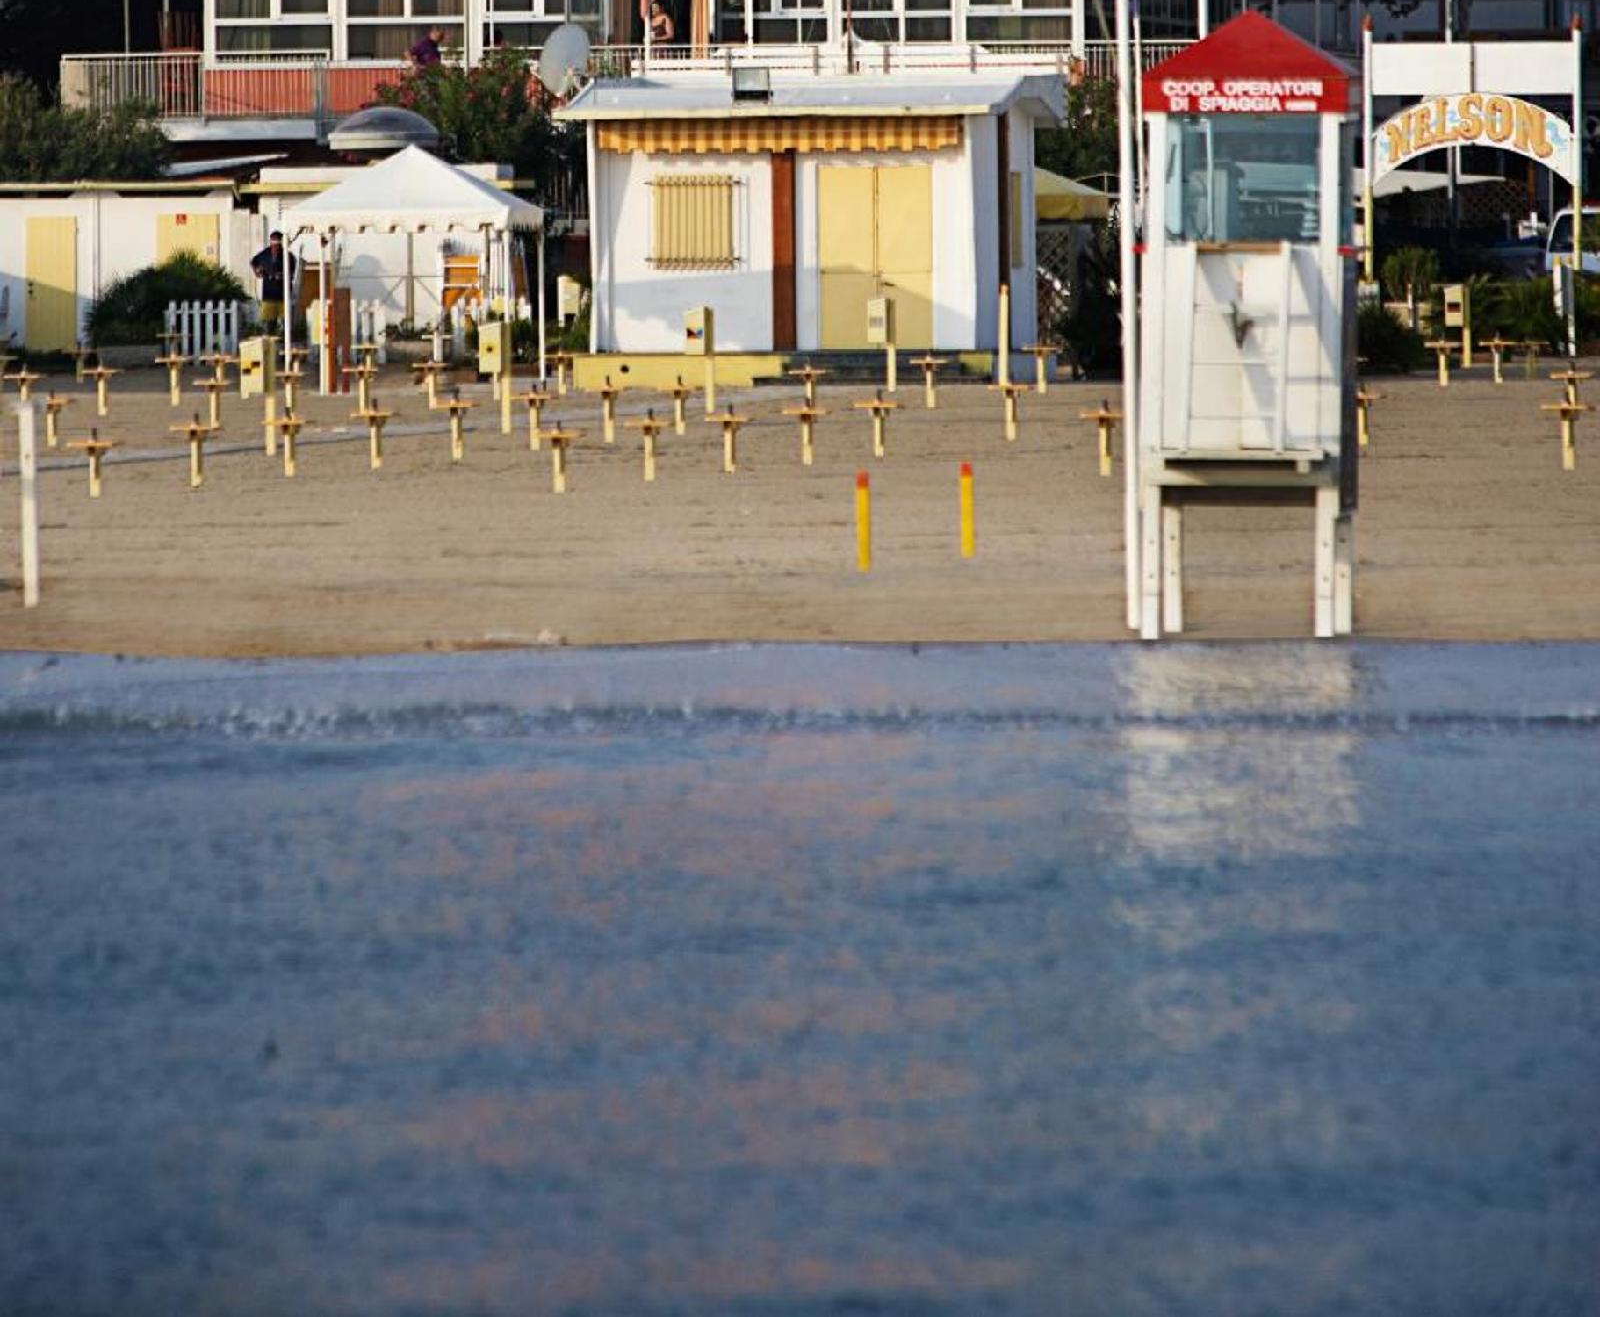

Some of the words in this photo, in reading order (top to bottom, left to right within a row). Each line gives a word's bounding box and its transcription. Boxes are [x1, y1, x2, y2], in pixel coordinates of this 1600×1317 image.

[1162, 80, 1219, 96] COOP.
[1223, 80, 1323, 96] OPERATORI
[1170, 97, 1189, 111] DI
[1199, 97, 1281, 111] SPIAGGIA
[1386, 93, 1553, 162] NELSON
